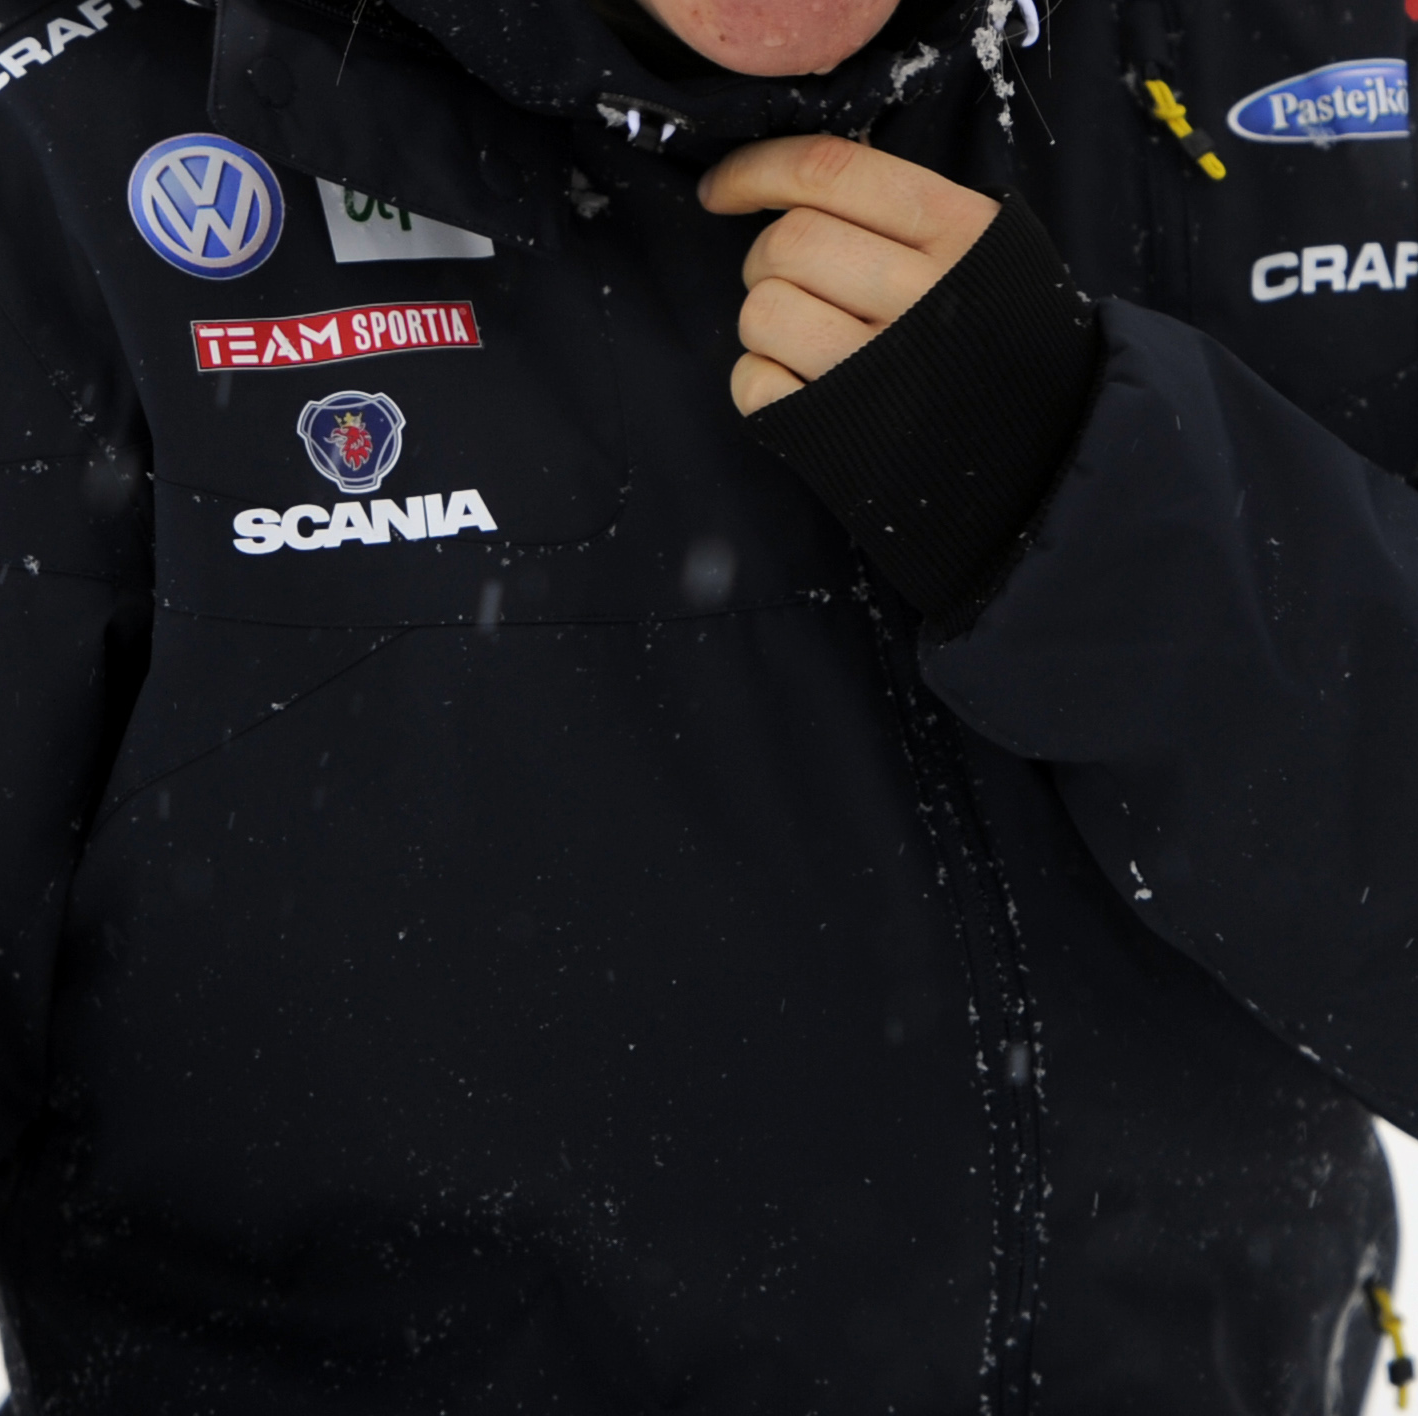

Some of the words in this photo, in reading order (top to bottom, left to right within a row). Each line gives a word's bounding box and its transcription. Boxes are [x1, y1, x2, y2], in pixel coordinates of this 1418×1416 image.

[199, 316, 343, 365] TEAM
[352, 307, 470, 351] SPORTIA
[233, 488, 498, 555] SCANIA
